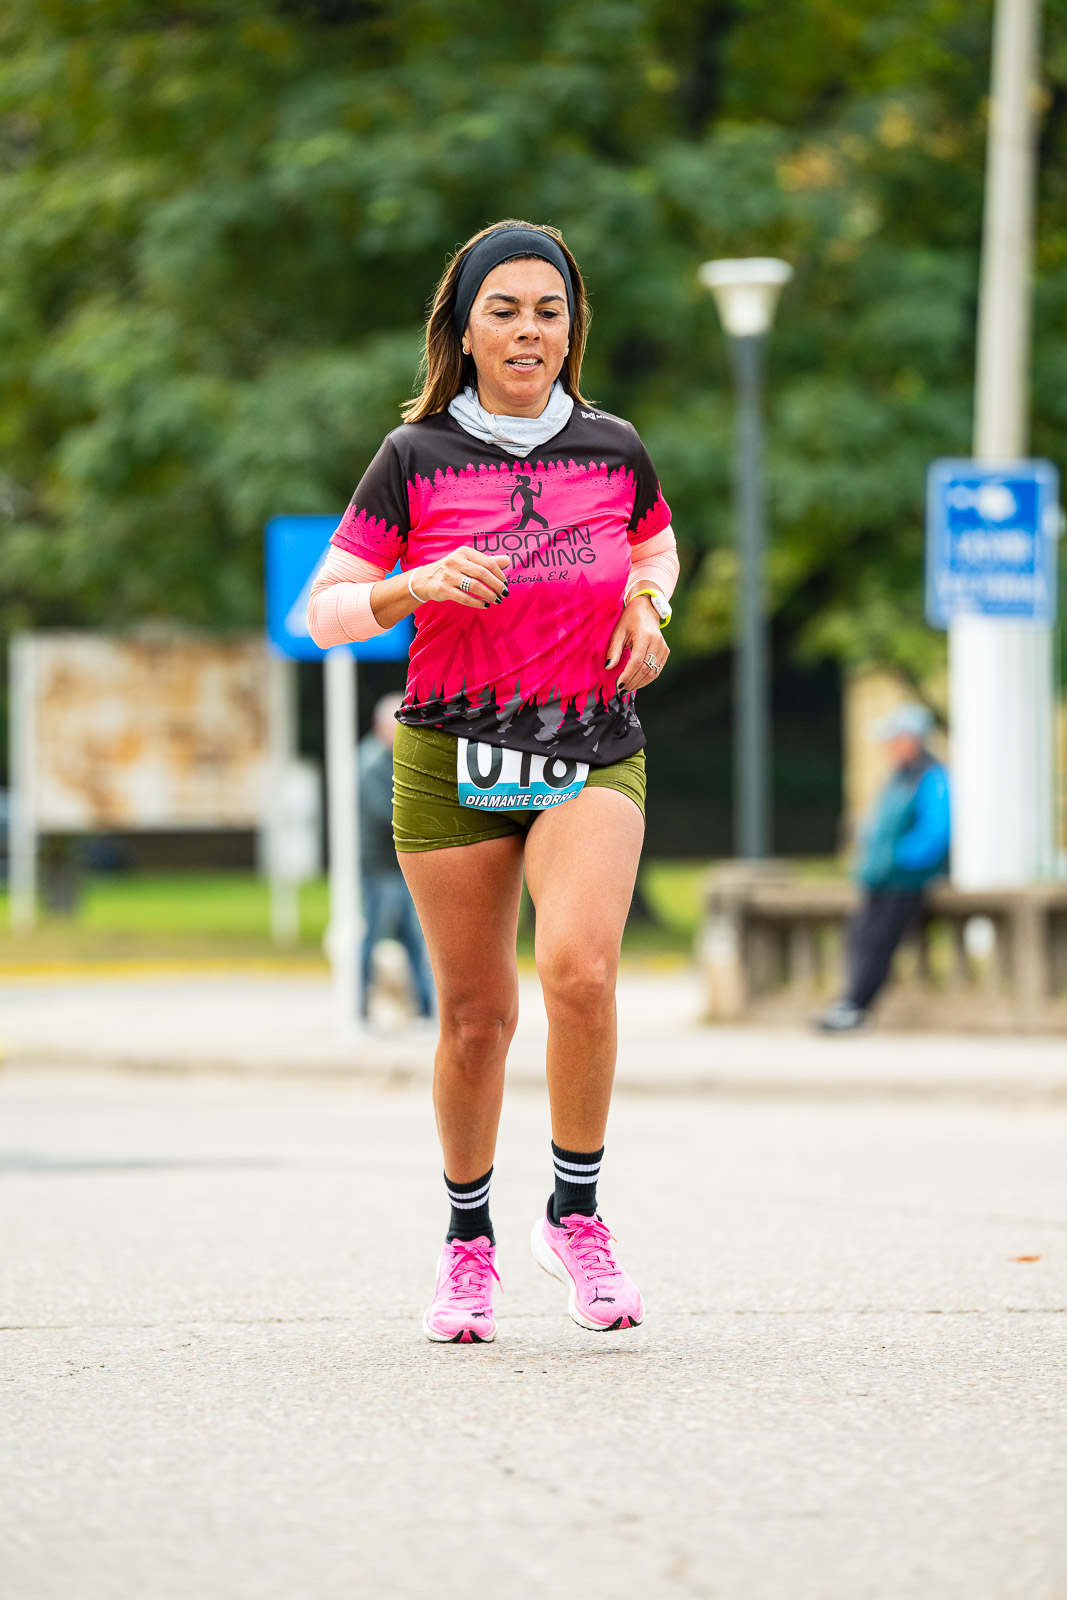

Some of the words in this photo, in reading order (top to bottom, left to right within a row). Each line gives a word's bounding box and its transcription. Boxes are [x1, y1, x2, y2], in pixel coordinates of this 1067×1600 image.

[473, 527, 592, 552] WOMAN
[490, 546, 597, 571] NNING
[465, 793, 532, 808] DIAMANTE
